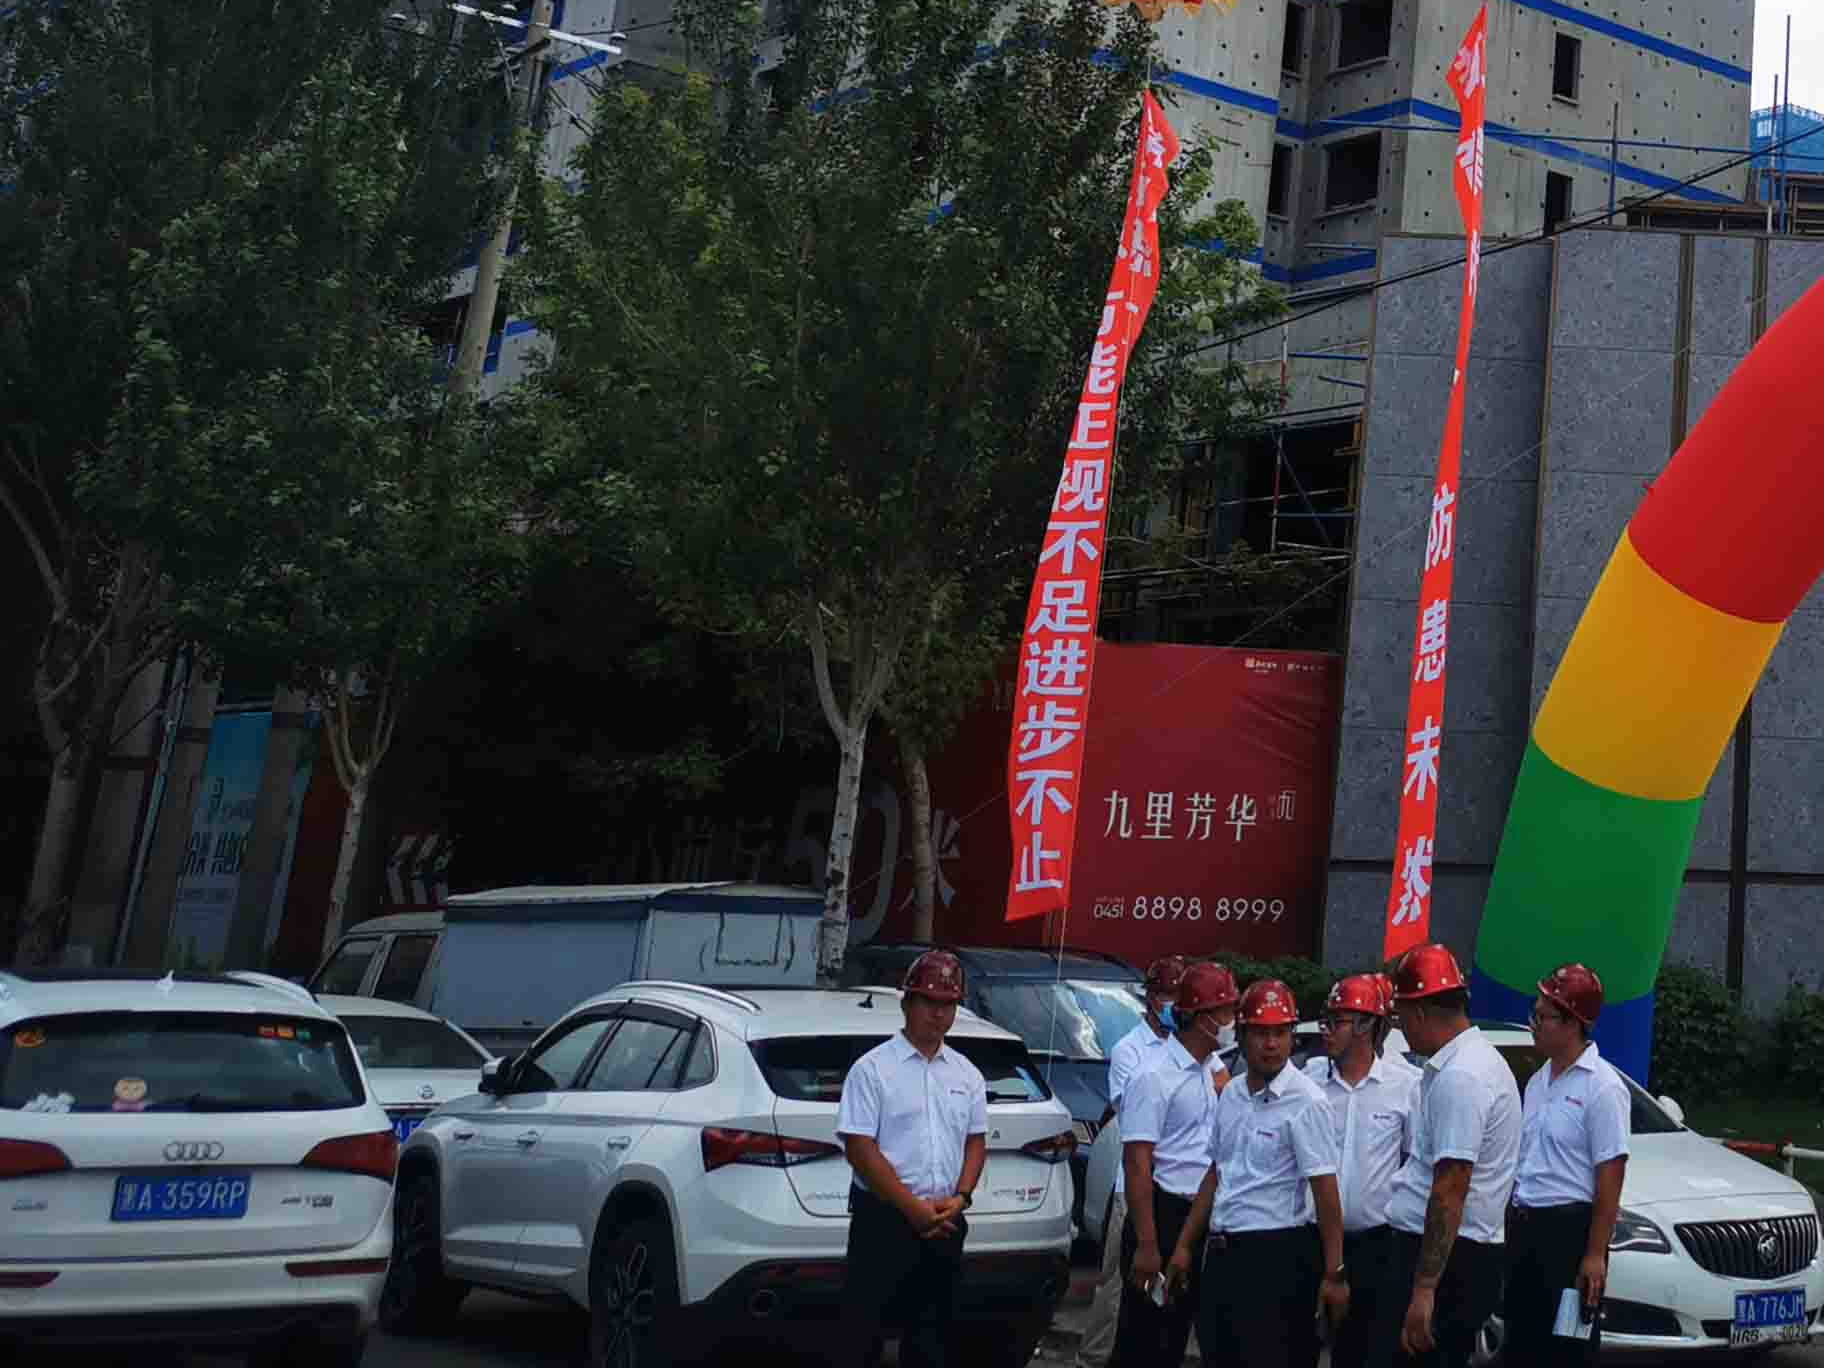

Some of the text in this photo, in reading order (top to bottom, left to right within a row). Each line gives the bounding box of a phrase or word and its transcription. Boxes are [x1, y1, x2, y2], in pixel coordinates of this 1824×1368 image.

[1392, 482, 1455, 926] 防患未然
[1103, 789, 1257, 842] 九里芳华
[1132, 895, 1201, 921] 8898
[1215, 896, 1285, 922] 8999
